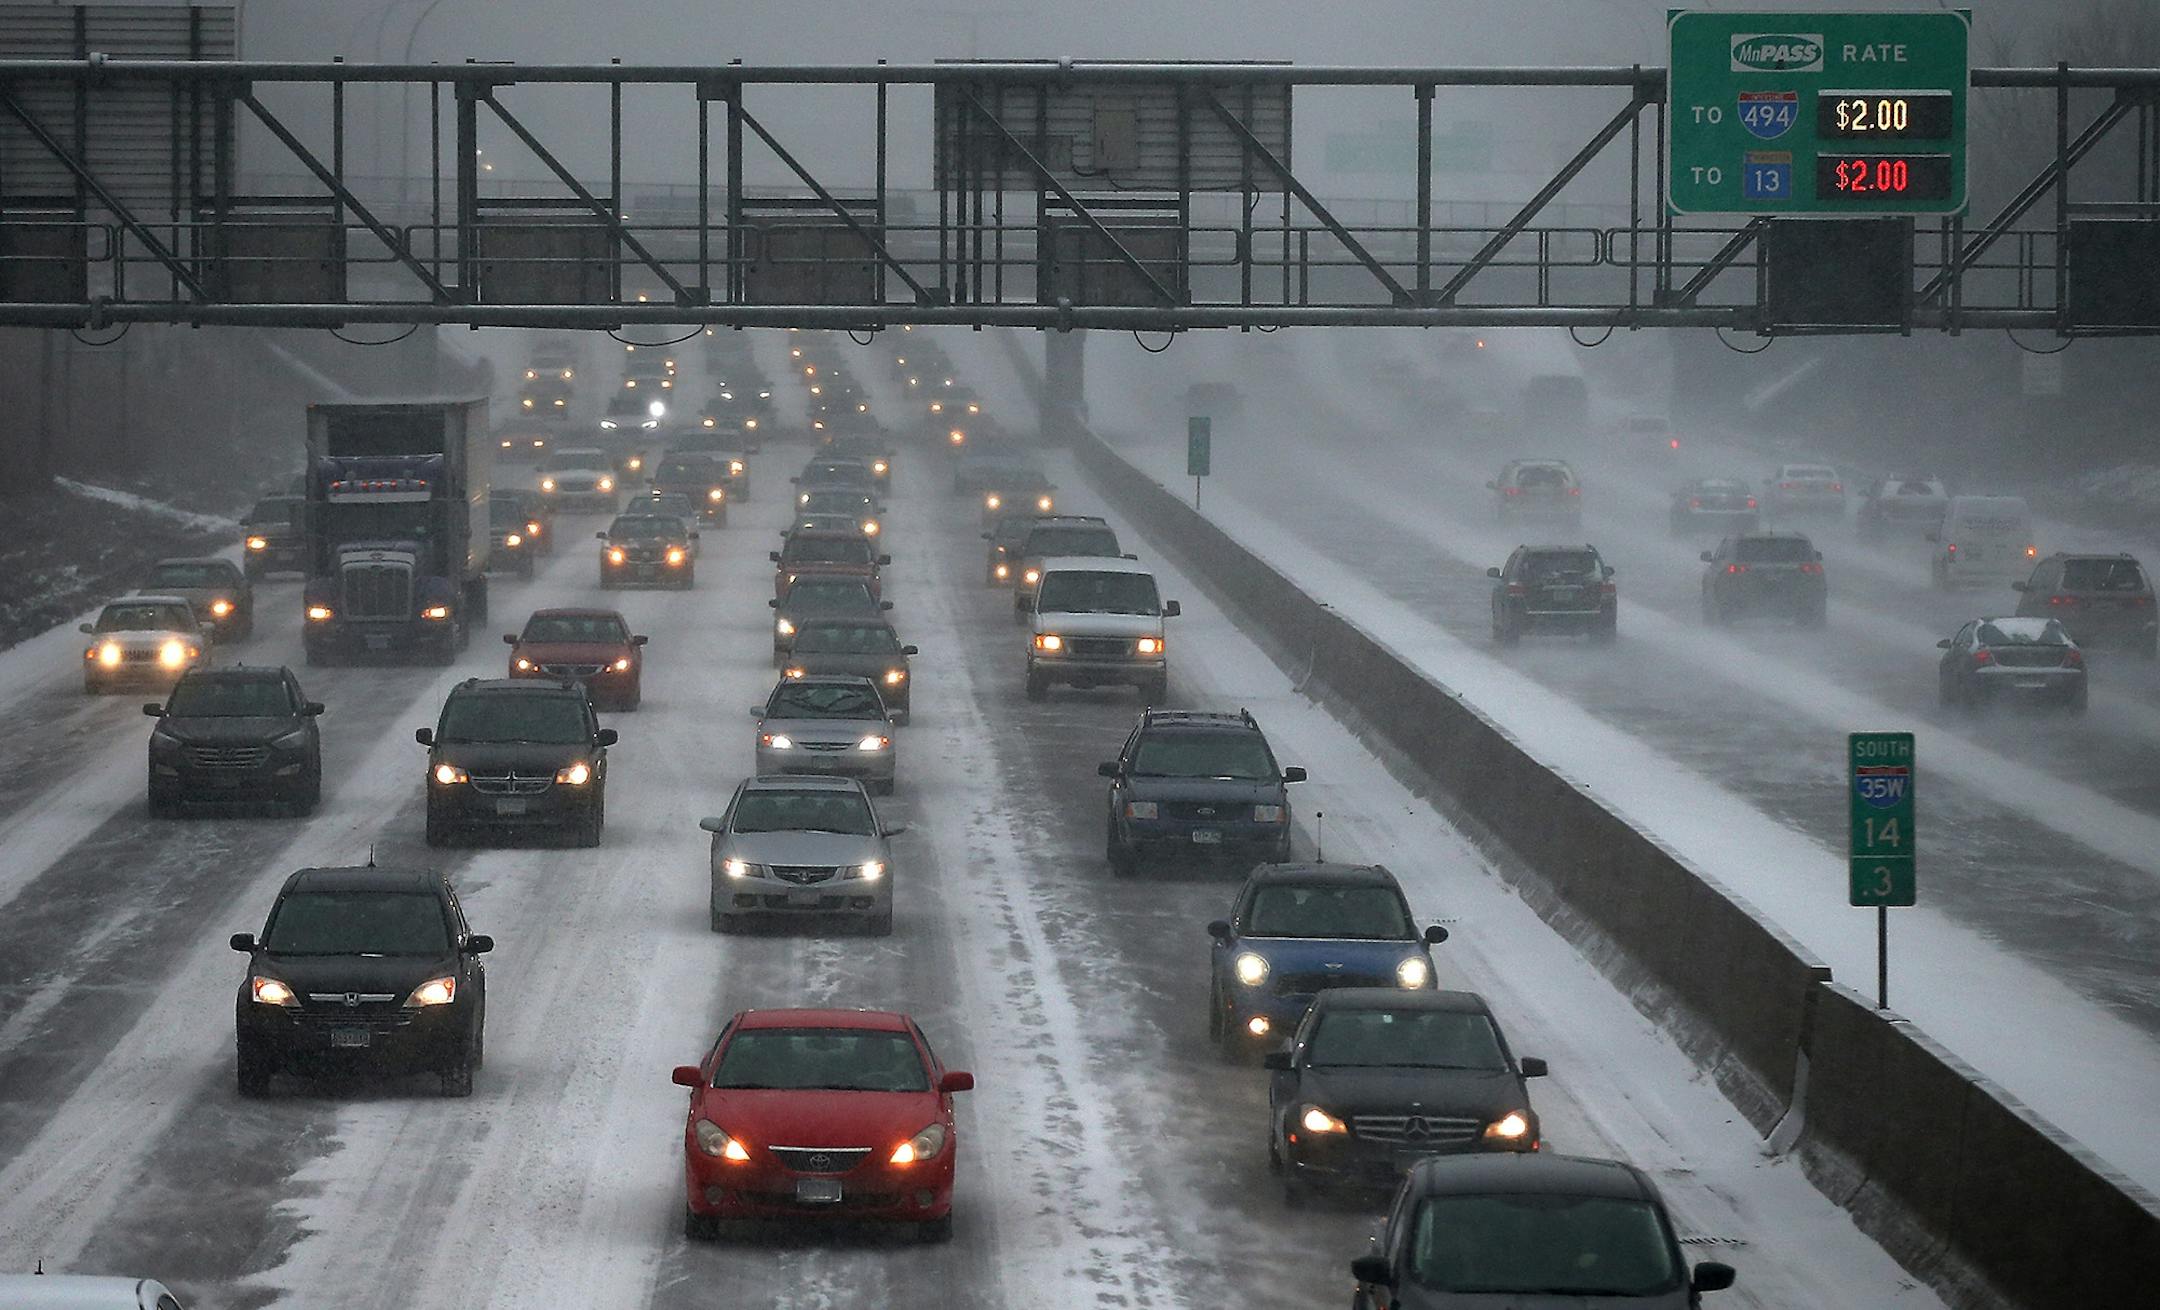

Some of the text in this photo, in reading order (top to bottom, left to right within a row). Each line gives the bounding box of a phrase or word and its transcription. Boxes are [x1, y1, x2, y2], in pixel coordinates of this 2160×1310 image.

[1738, 44, 1908, 62] MnPASS RATE
[1691, 105, 1790, 127] TO 494
[1835, 99, 1908, 131] $2.00
[1691, 167, 1780, 192] TO 13
[1835, 160, 1908, 192] $2.00
[1855, 741, 1909, 757] SOUTH
[1862, 778, 1904, 798] 35W
[1865, 817, 1900, 847] 14
